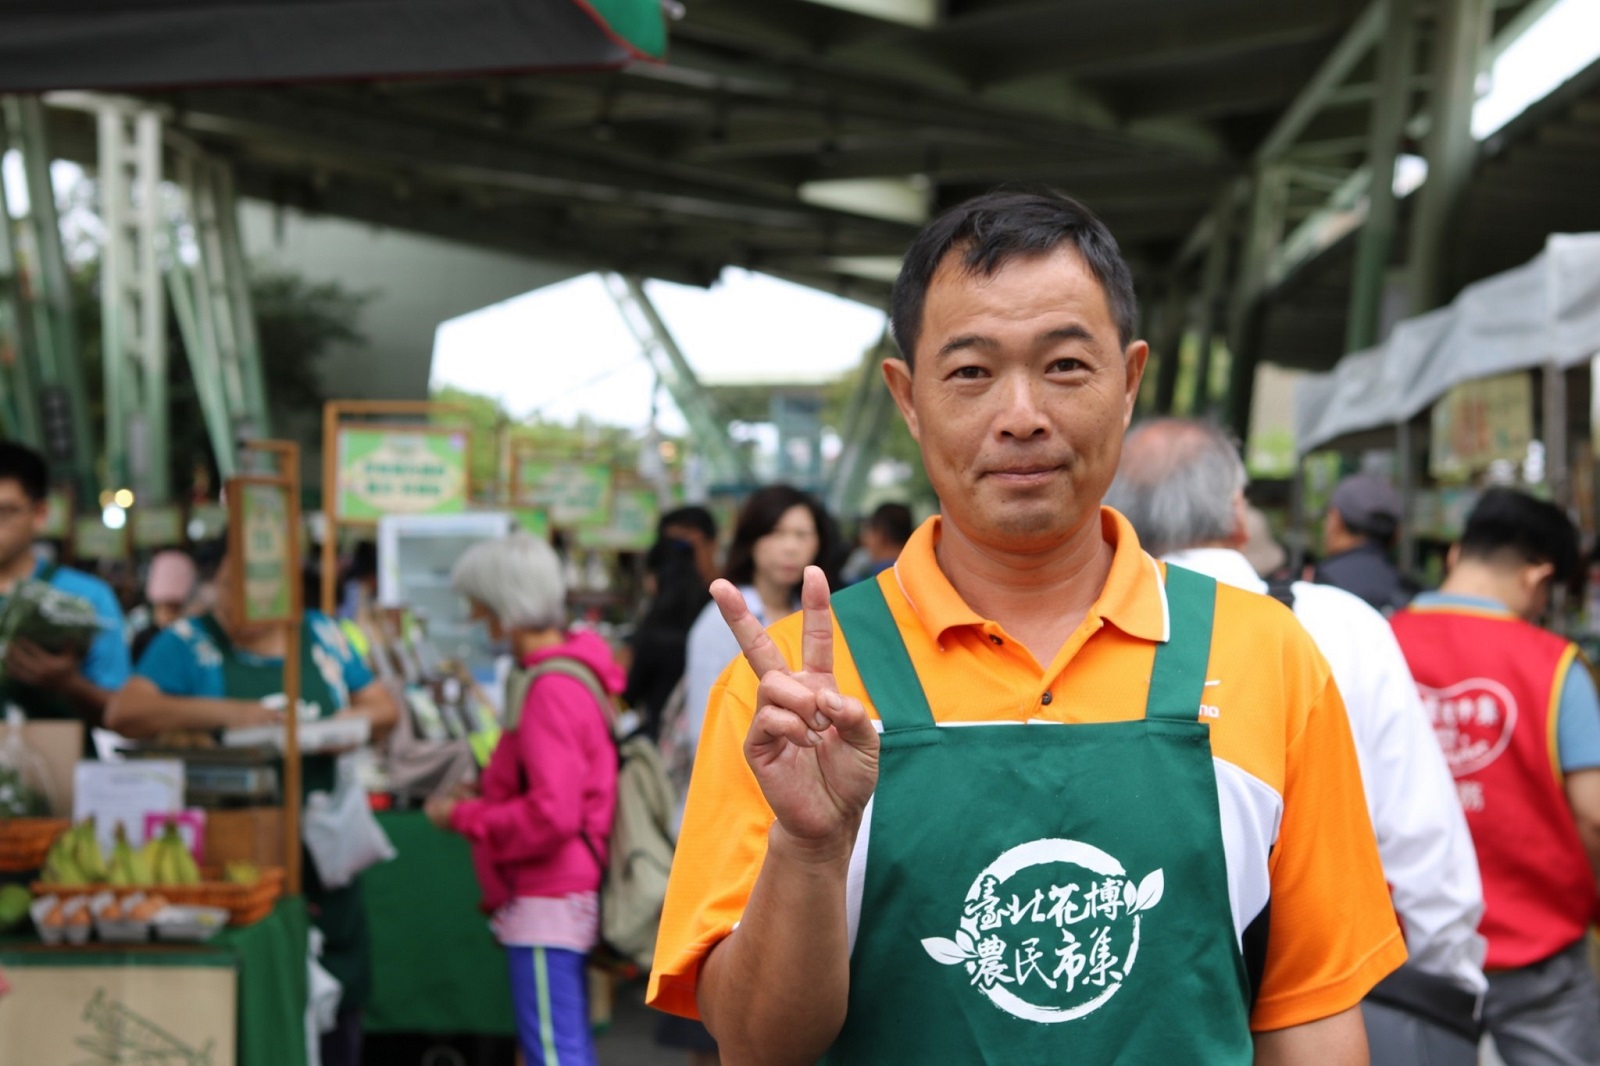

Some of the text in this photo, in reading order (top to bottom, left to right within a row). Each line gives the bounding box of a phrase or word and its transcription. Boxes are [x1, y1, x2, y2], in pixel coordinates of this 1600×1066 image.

[965, 878, 1125, 930] 臺北花博
[970, 927, 1123, 992] 農民市集
